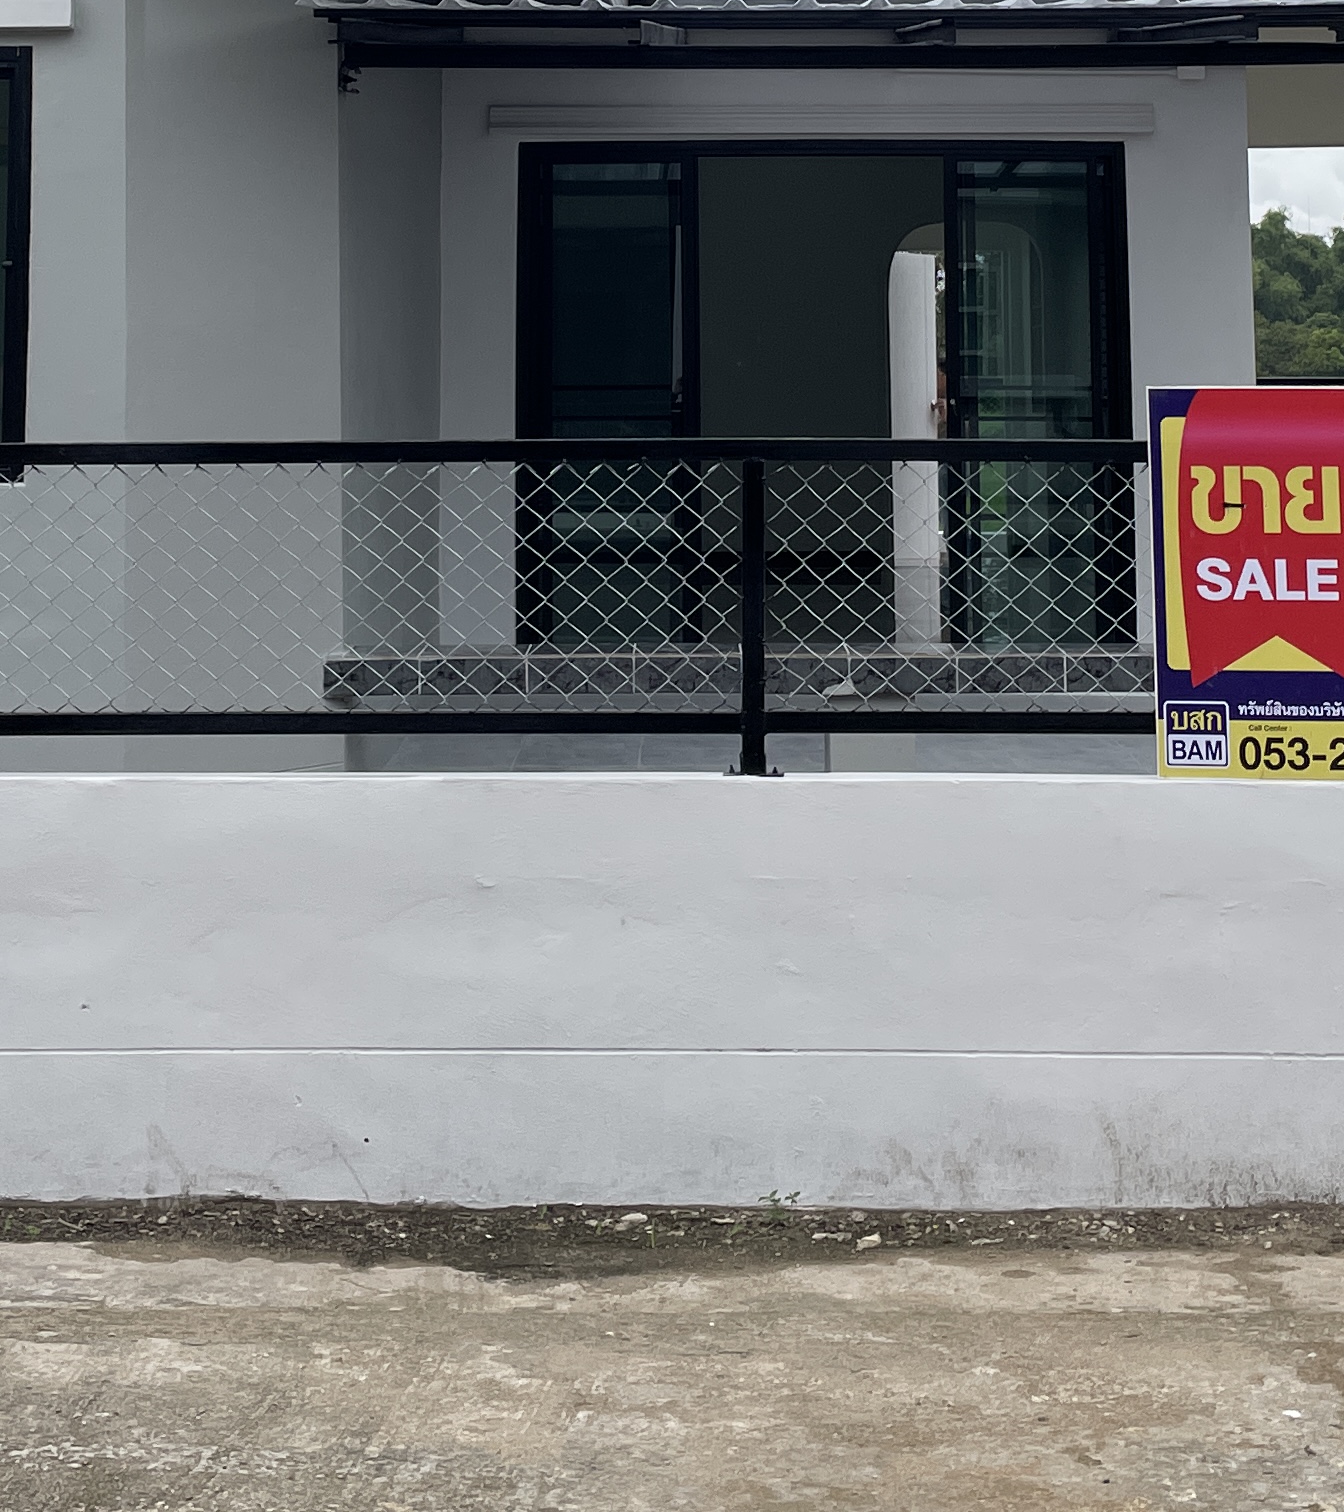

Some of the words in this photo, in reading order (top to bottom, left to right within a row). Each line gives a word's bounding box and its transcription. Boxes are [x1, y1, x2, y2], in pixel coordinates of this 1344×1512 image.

[1190, 464, 1342, 535] ขาย
[1196, 557, 1340, 602] SALE
[1170, 709, 1223, 732] บสก
[1248, 723, 1263, 732] Call
[1171, 739, 1223, 761] BAM
